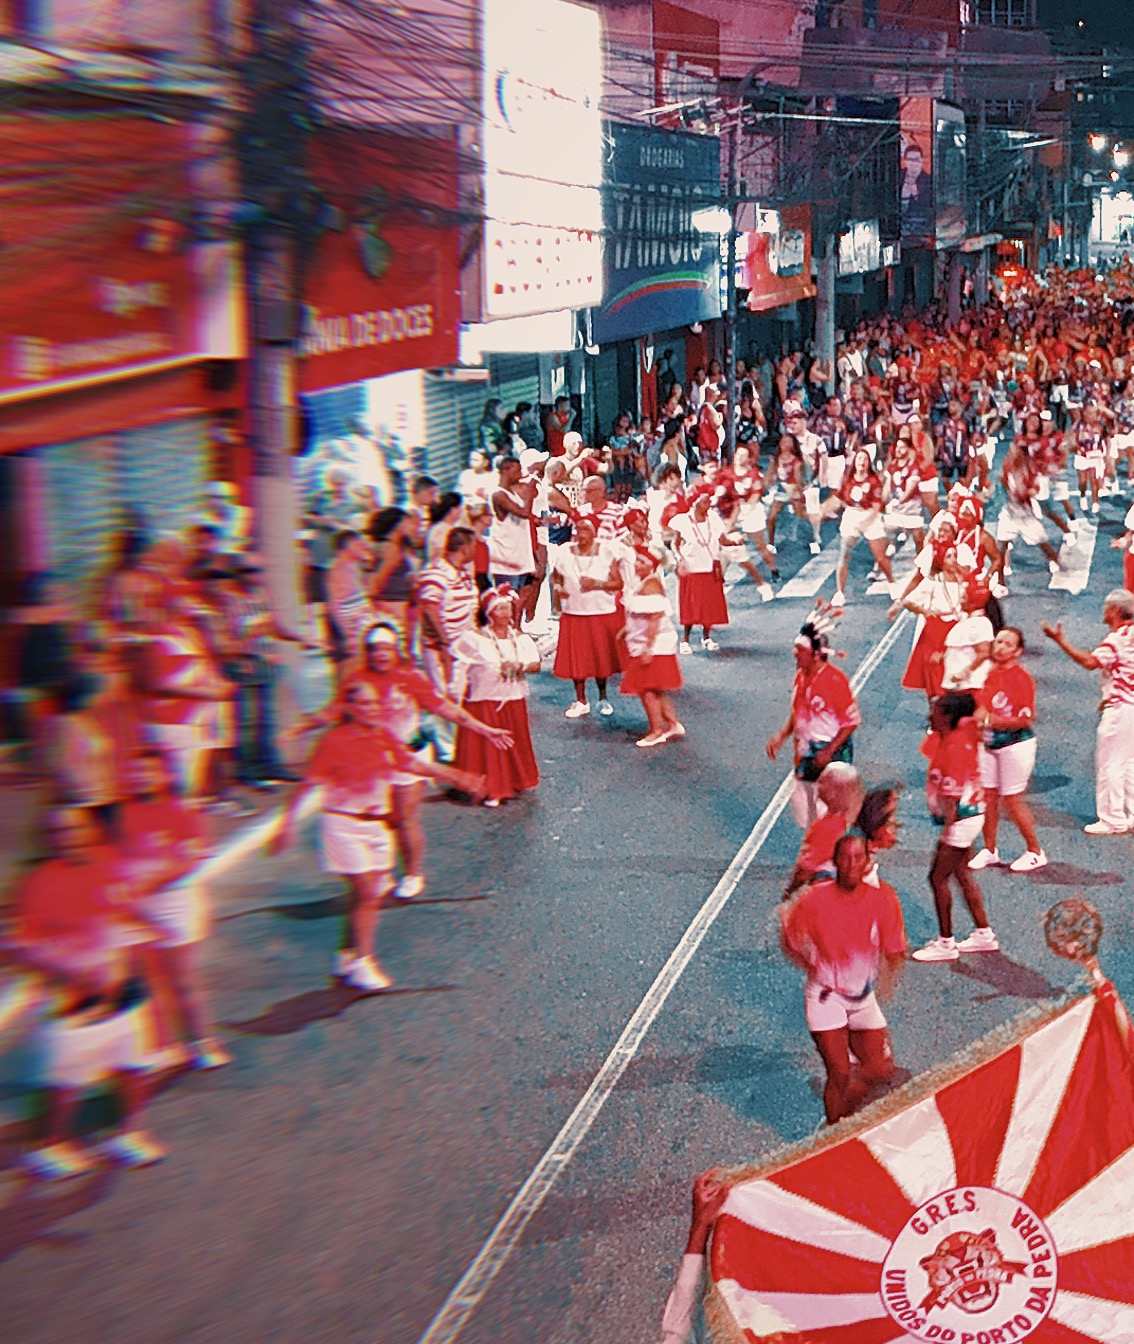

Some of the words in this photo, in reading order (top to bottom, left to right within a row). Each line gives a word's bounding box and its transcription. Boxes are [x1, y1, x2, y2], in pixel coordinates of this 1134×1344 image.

[639, 146, 684, 168] DROGARIAS
[348, 310, 377, 347] DE
[377, 303, 433, 344] DOCES
[1011, 1207, 1053, 1278] PEDRA
[885, 1269, 927, 1331] UNIDOS
[1025, 1287, 1053, 1314] DA
[925, 1325, 956, 1342] DO
